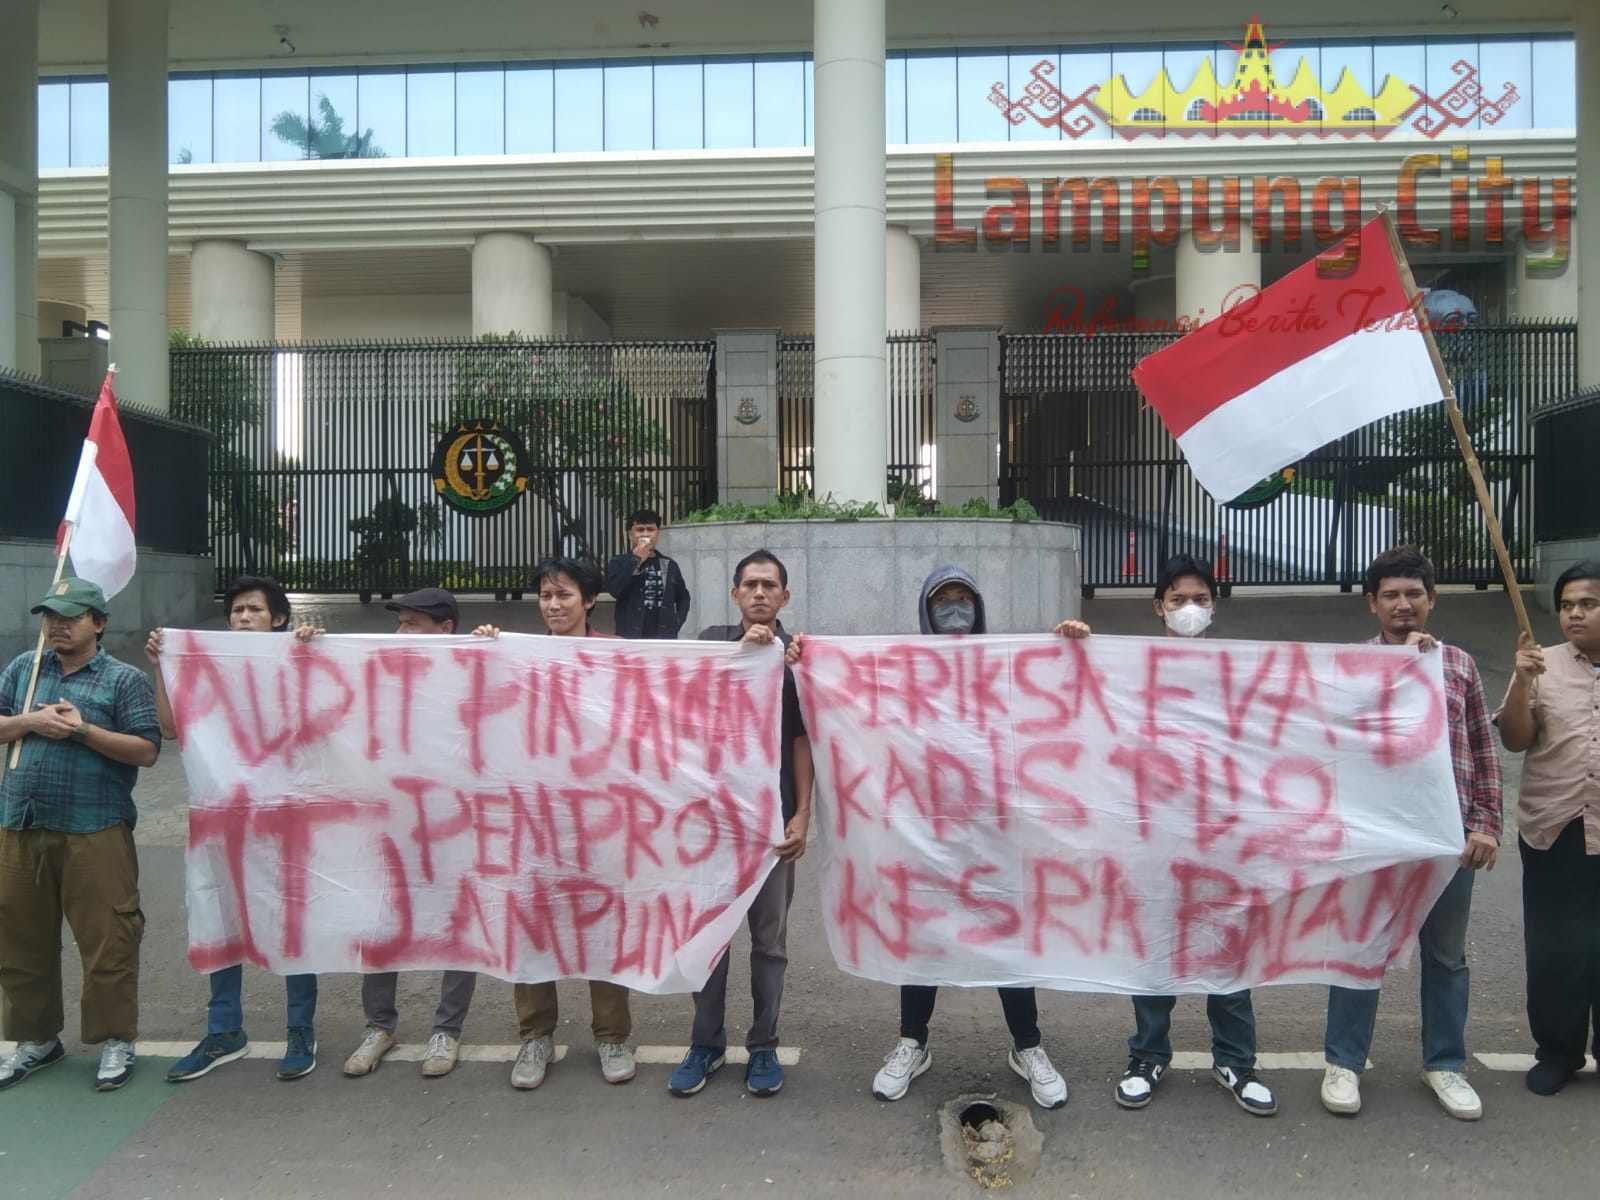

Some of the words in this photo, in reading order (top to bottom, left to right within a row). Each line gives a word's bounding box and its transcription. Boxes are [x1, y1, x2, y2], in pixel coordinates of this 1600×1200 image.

[173, 632, 434, 768] AUDIT
[803, 637, 1117, 746] PERIKSA
[826, 733, 1090, 842] KADIS
[835, 853, 1147, 970] KESRA
